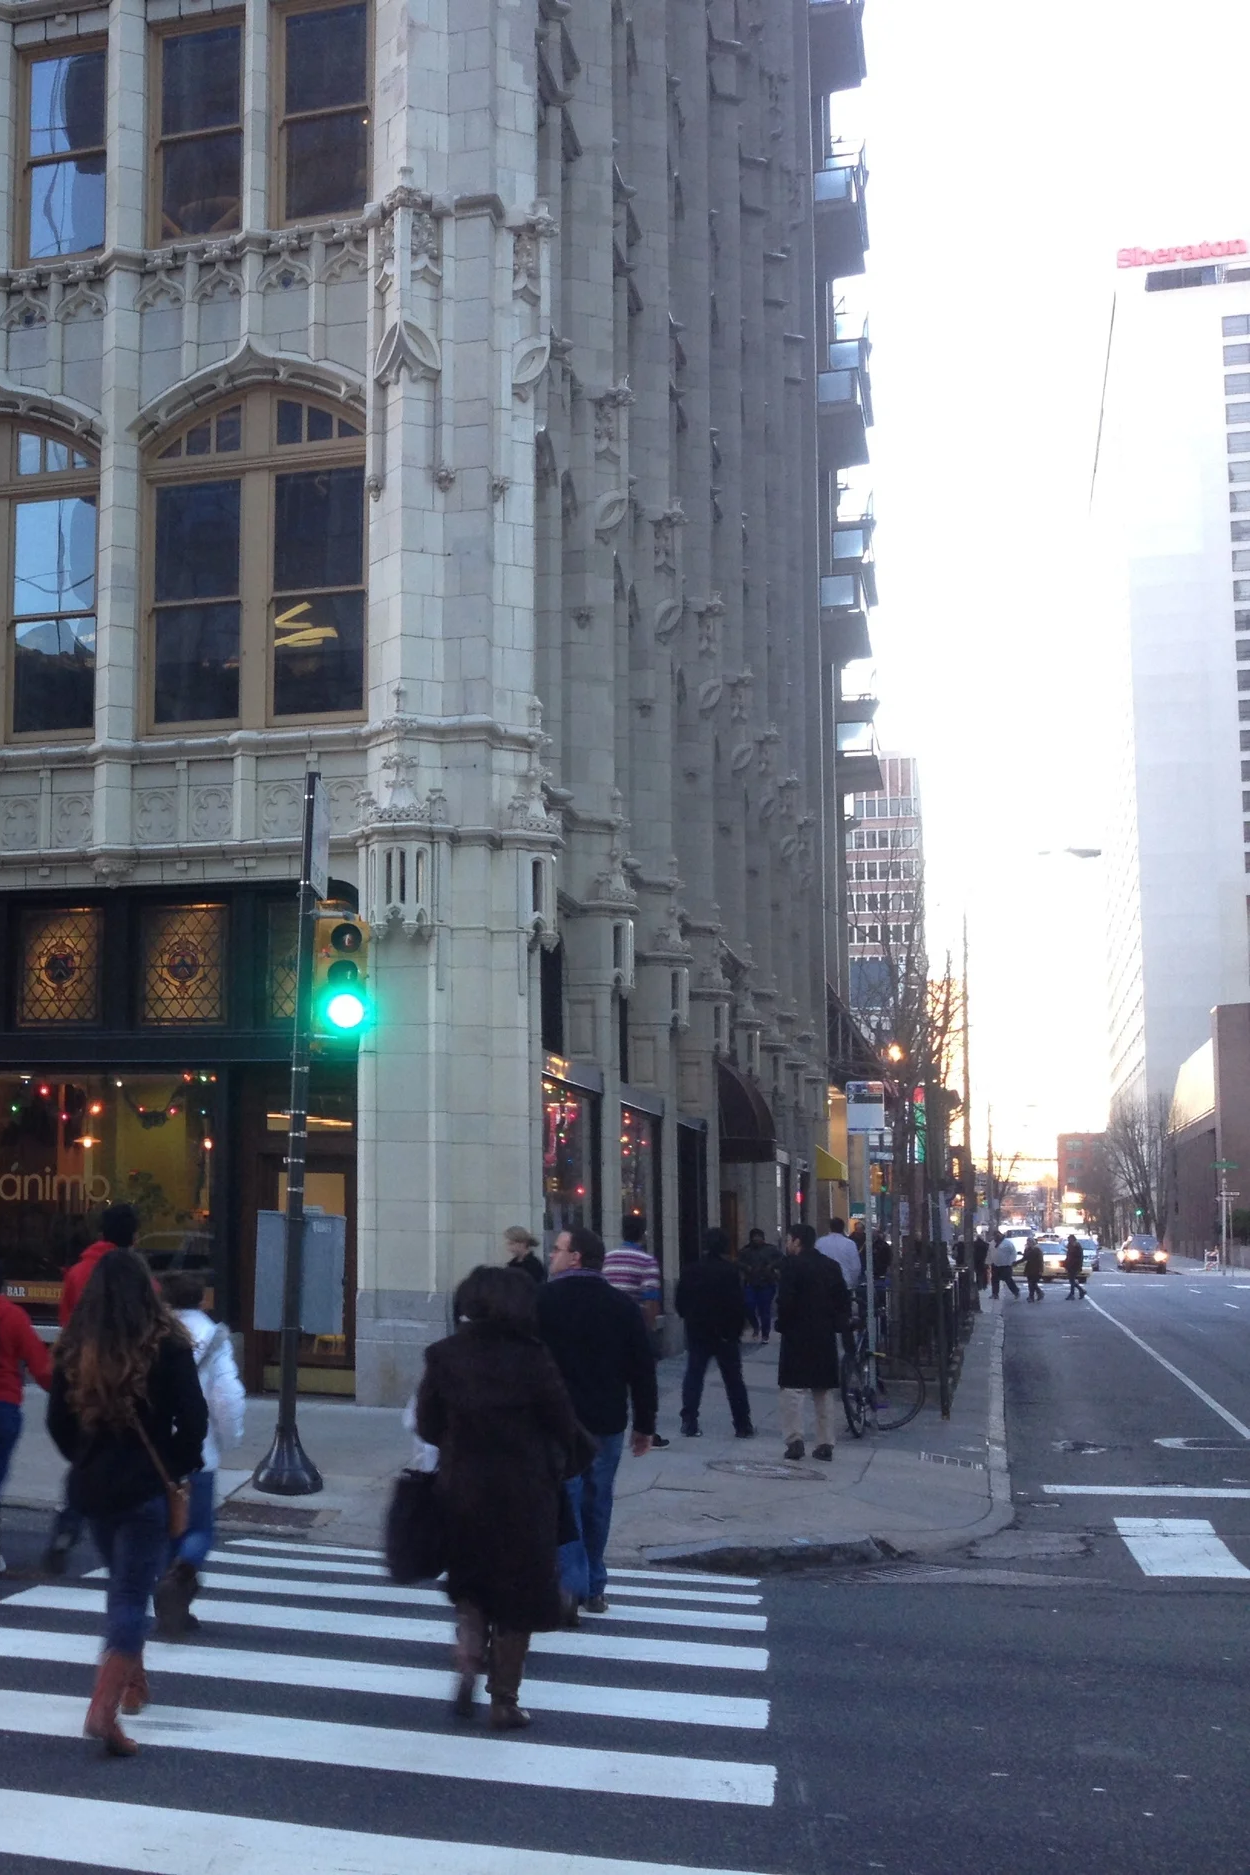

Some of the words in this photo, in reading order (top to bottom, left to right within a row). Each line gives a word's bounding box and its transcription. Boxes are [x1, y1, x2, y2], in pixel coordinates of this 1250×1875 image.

[1117, 239, 1247, 268] Sheraton
[6, 1286, 26, 1297] BAR
[27, 1287, 62, 1298] BURRIT
